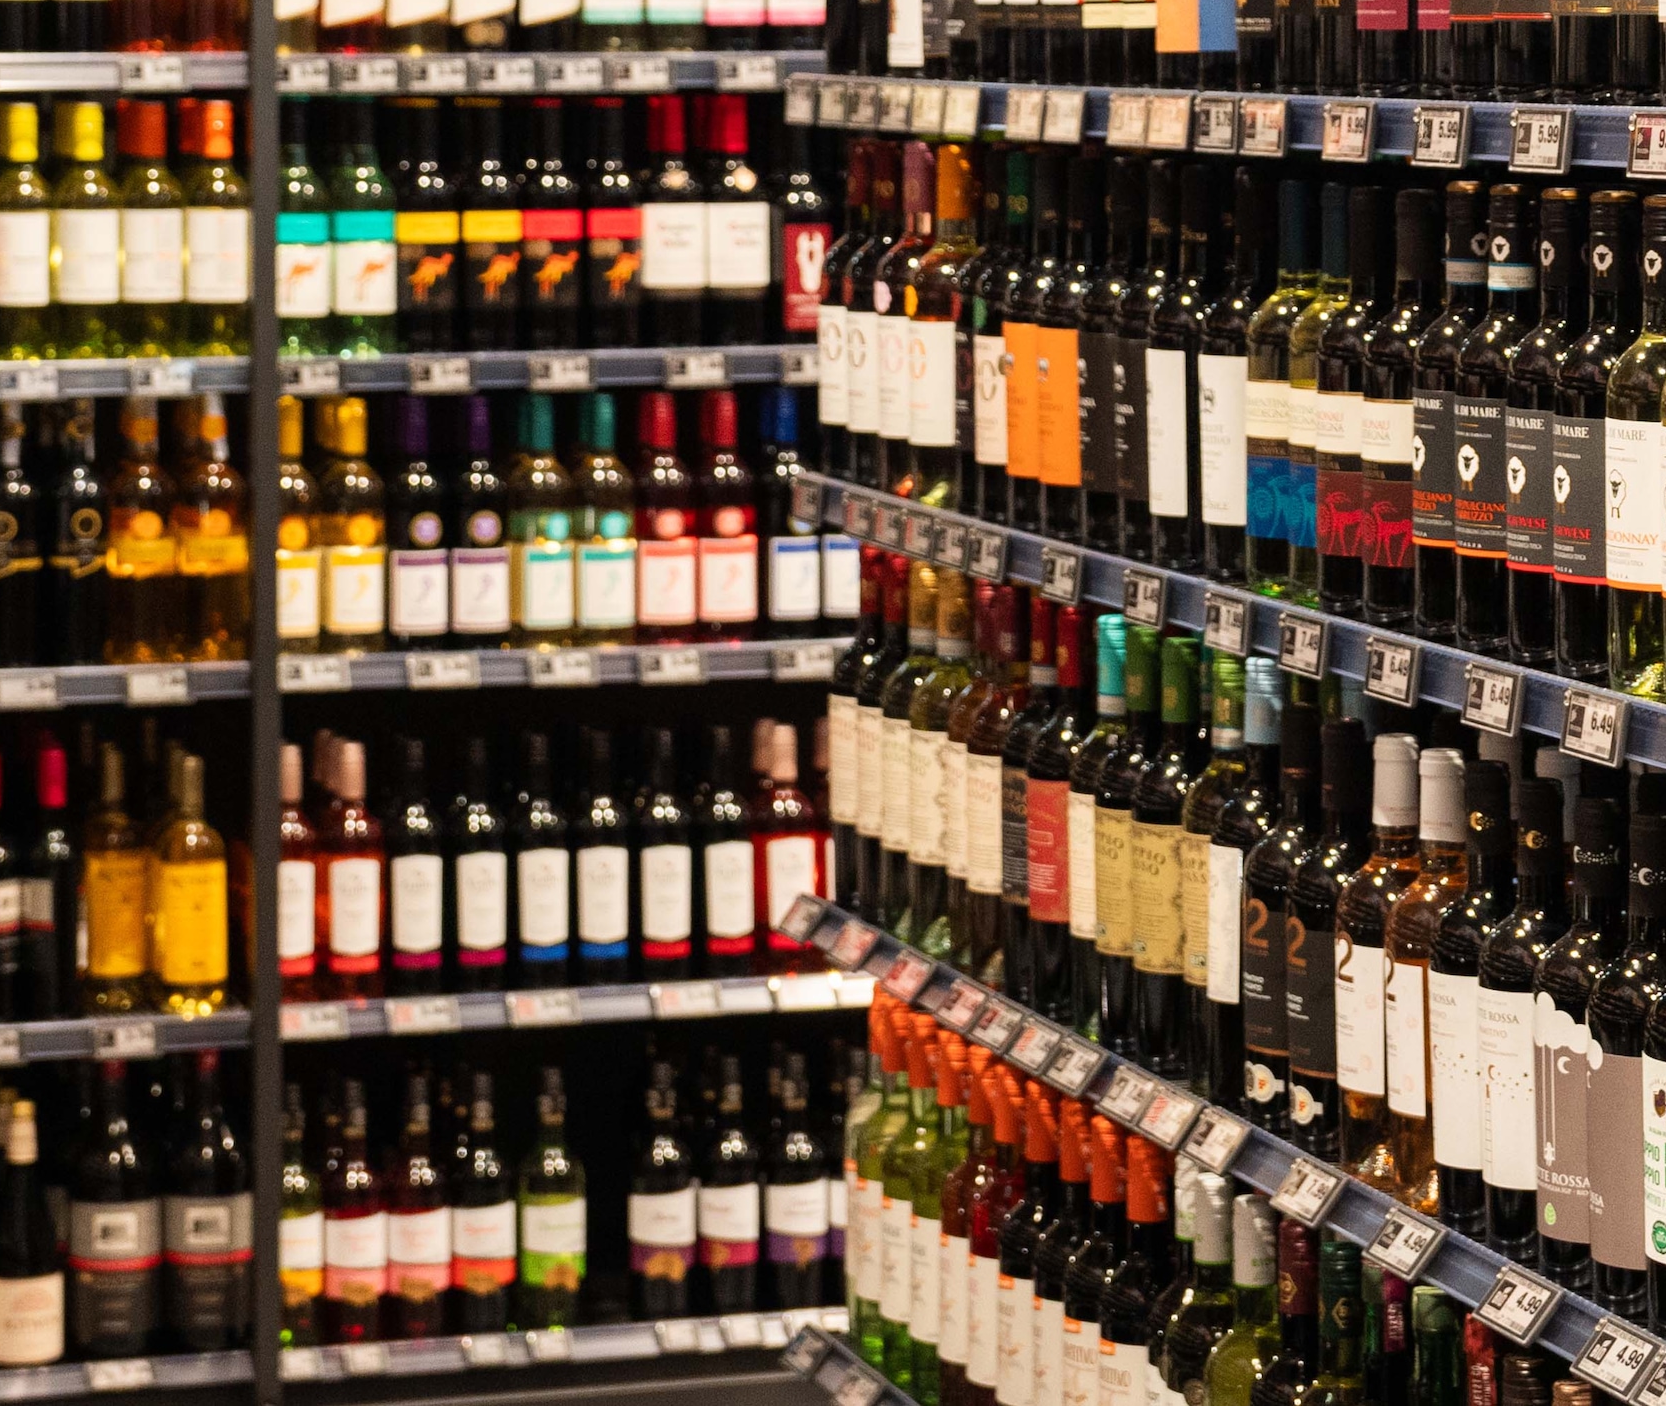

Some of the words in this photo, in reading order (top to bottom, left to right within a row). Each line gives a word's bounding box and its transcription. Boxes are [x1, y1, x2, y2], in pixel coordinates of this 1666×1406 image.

[1537, 124, 1560, 145] 5.99
[1564, 424, 1590, 440] MARE
[1620, 428, 1647, 444] MARE
[1490, 683, 1512, 708] 6.49
[1590, 709, 1614, 737] 6.49
[1402, 1230, 1429, 1255] 4.99
[1516, 1286, 1541, 1315] 4.99
[1616, 1345, 1643, 1371] 4.99
